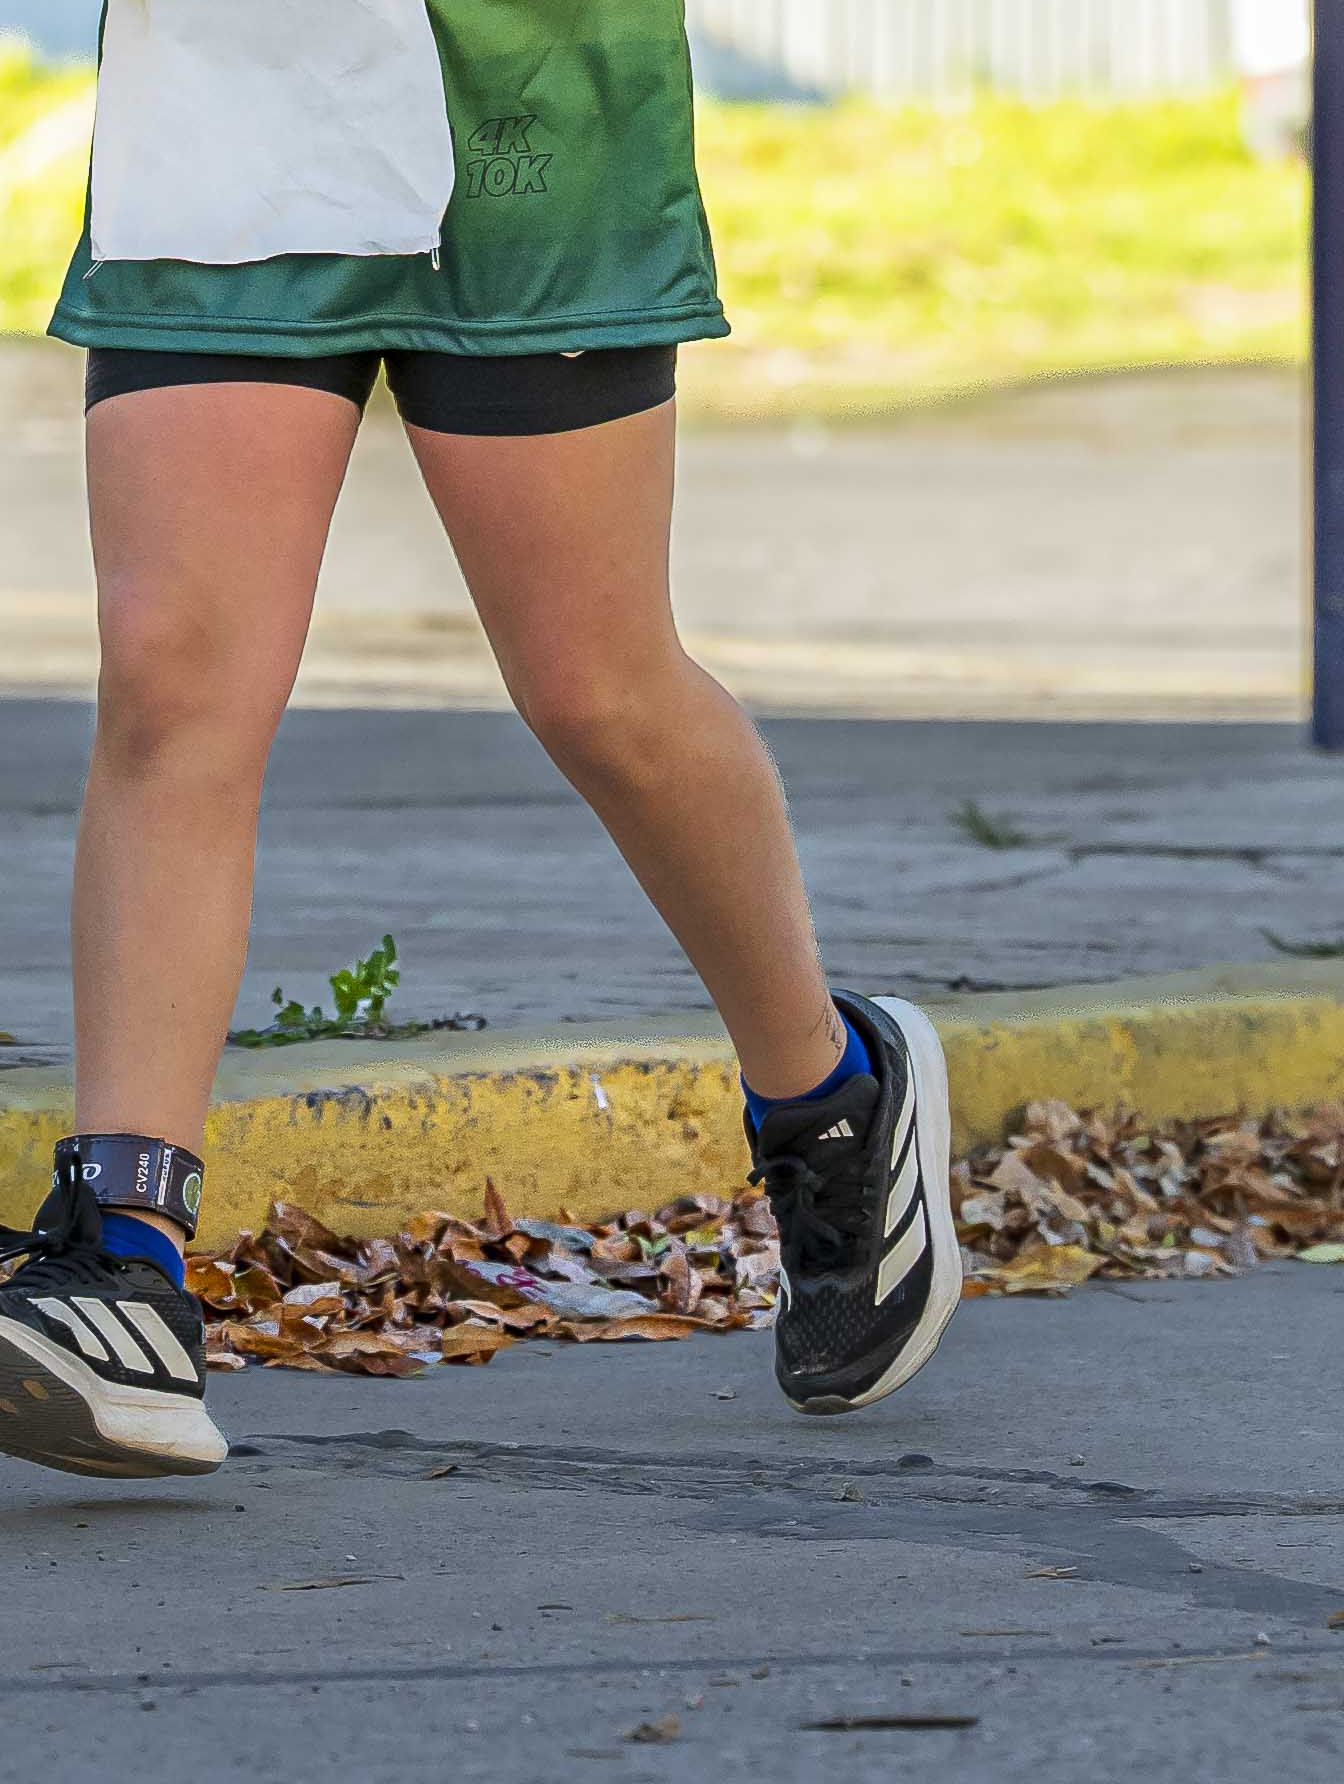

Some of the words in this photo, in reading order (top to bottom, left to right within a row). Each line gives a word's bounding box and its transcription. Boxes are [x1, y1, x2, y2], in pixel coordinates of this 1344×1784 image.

[467, 114, 538, 156] 4K
[465, 153, 554, 199] 10K
[135, 1153, 151, 1193] CV240
